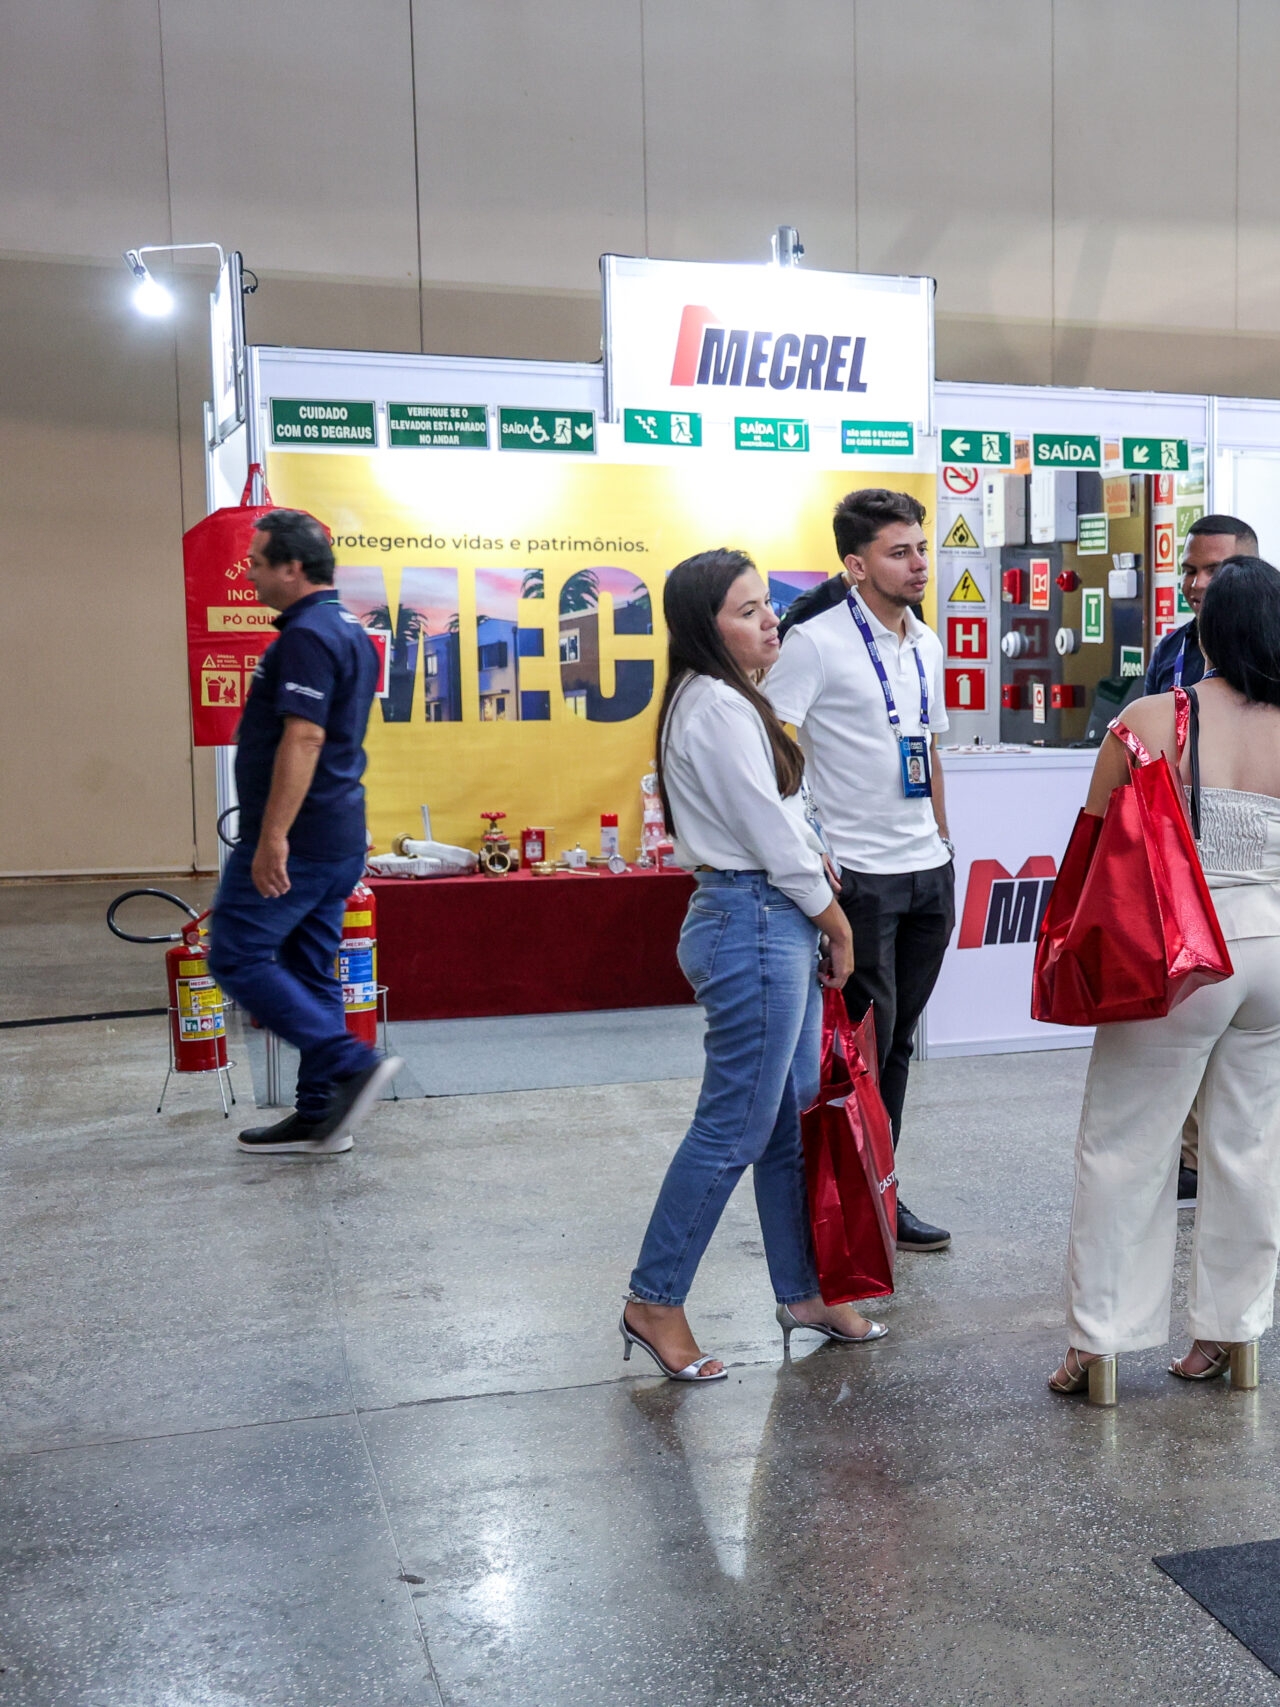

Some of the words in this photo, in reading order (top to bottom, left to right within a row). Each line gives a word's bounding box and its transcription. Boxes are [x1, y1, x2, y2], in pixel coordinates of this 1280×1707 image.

[696, 327, 868, 393] MECREL
[299, 405, 348, 421] CUIDADO
[407, 406, 449, 418] VERIFIQUE
[451, 407, 461, 418] SE
[462, 408, 469, 418] O
[276, 424, 301, 437] COM
[303, 425, 319, 438] OS
[321, 426, 373, 440] DEGRAUS
[390, 420, 432, 431] ELEVADOR
[433, 421, 454, 432] ESTA
[455, 422, 486, 433] PARADO
[502, 421, 530, 435] SAÍDA
[740, 421, 775, 435] SAÍDA
[419, 433, 432, 444] NO
[432, 434, 460, 445] ANDAR
[1037, 440, 1097, 462] SAÍDA
[330, 532, 446, 552] protegendo
[451, 534, 504, 551] vidas
[509, 539, 522, 551] e
[527, 536, 650, 554] patrimônios.
[334, 565, 657, 723] MEC
[955, 623, 979, 653] H
